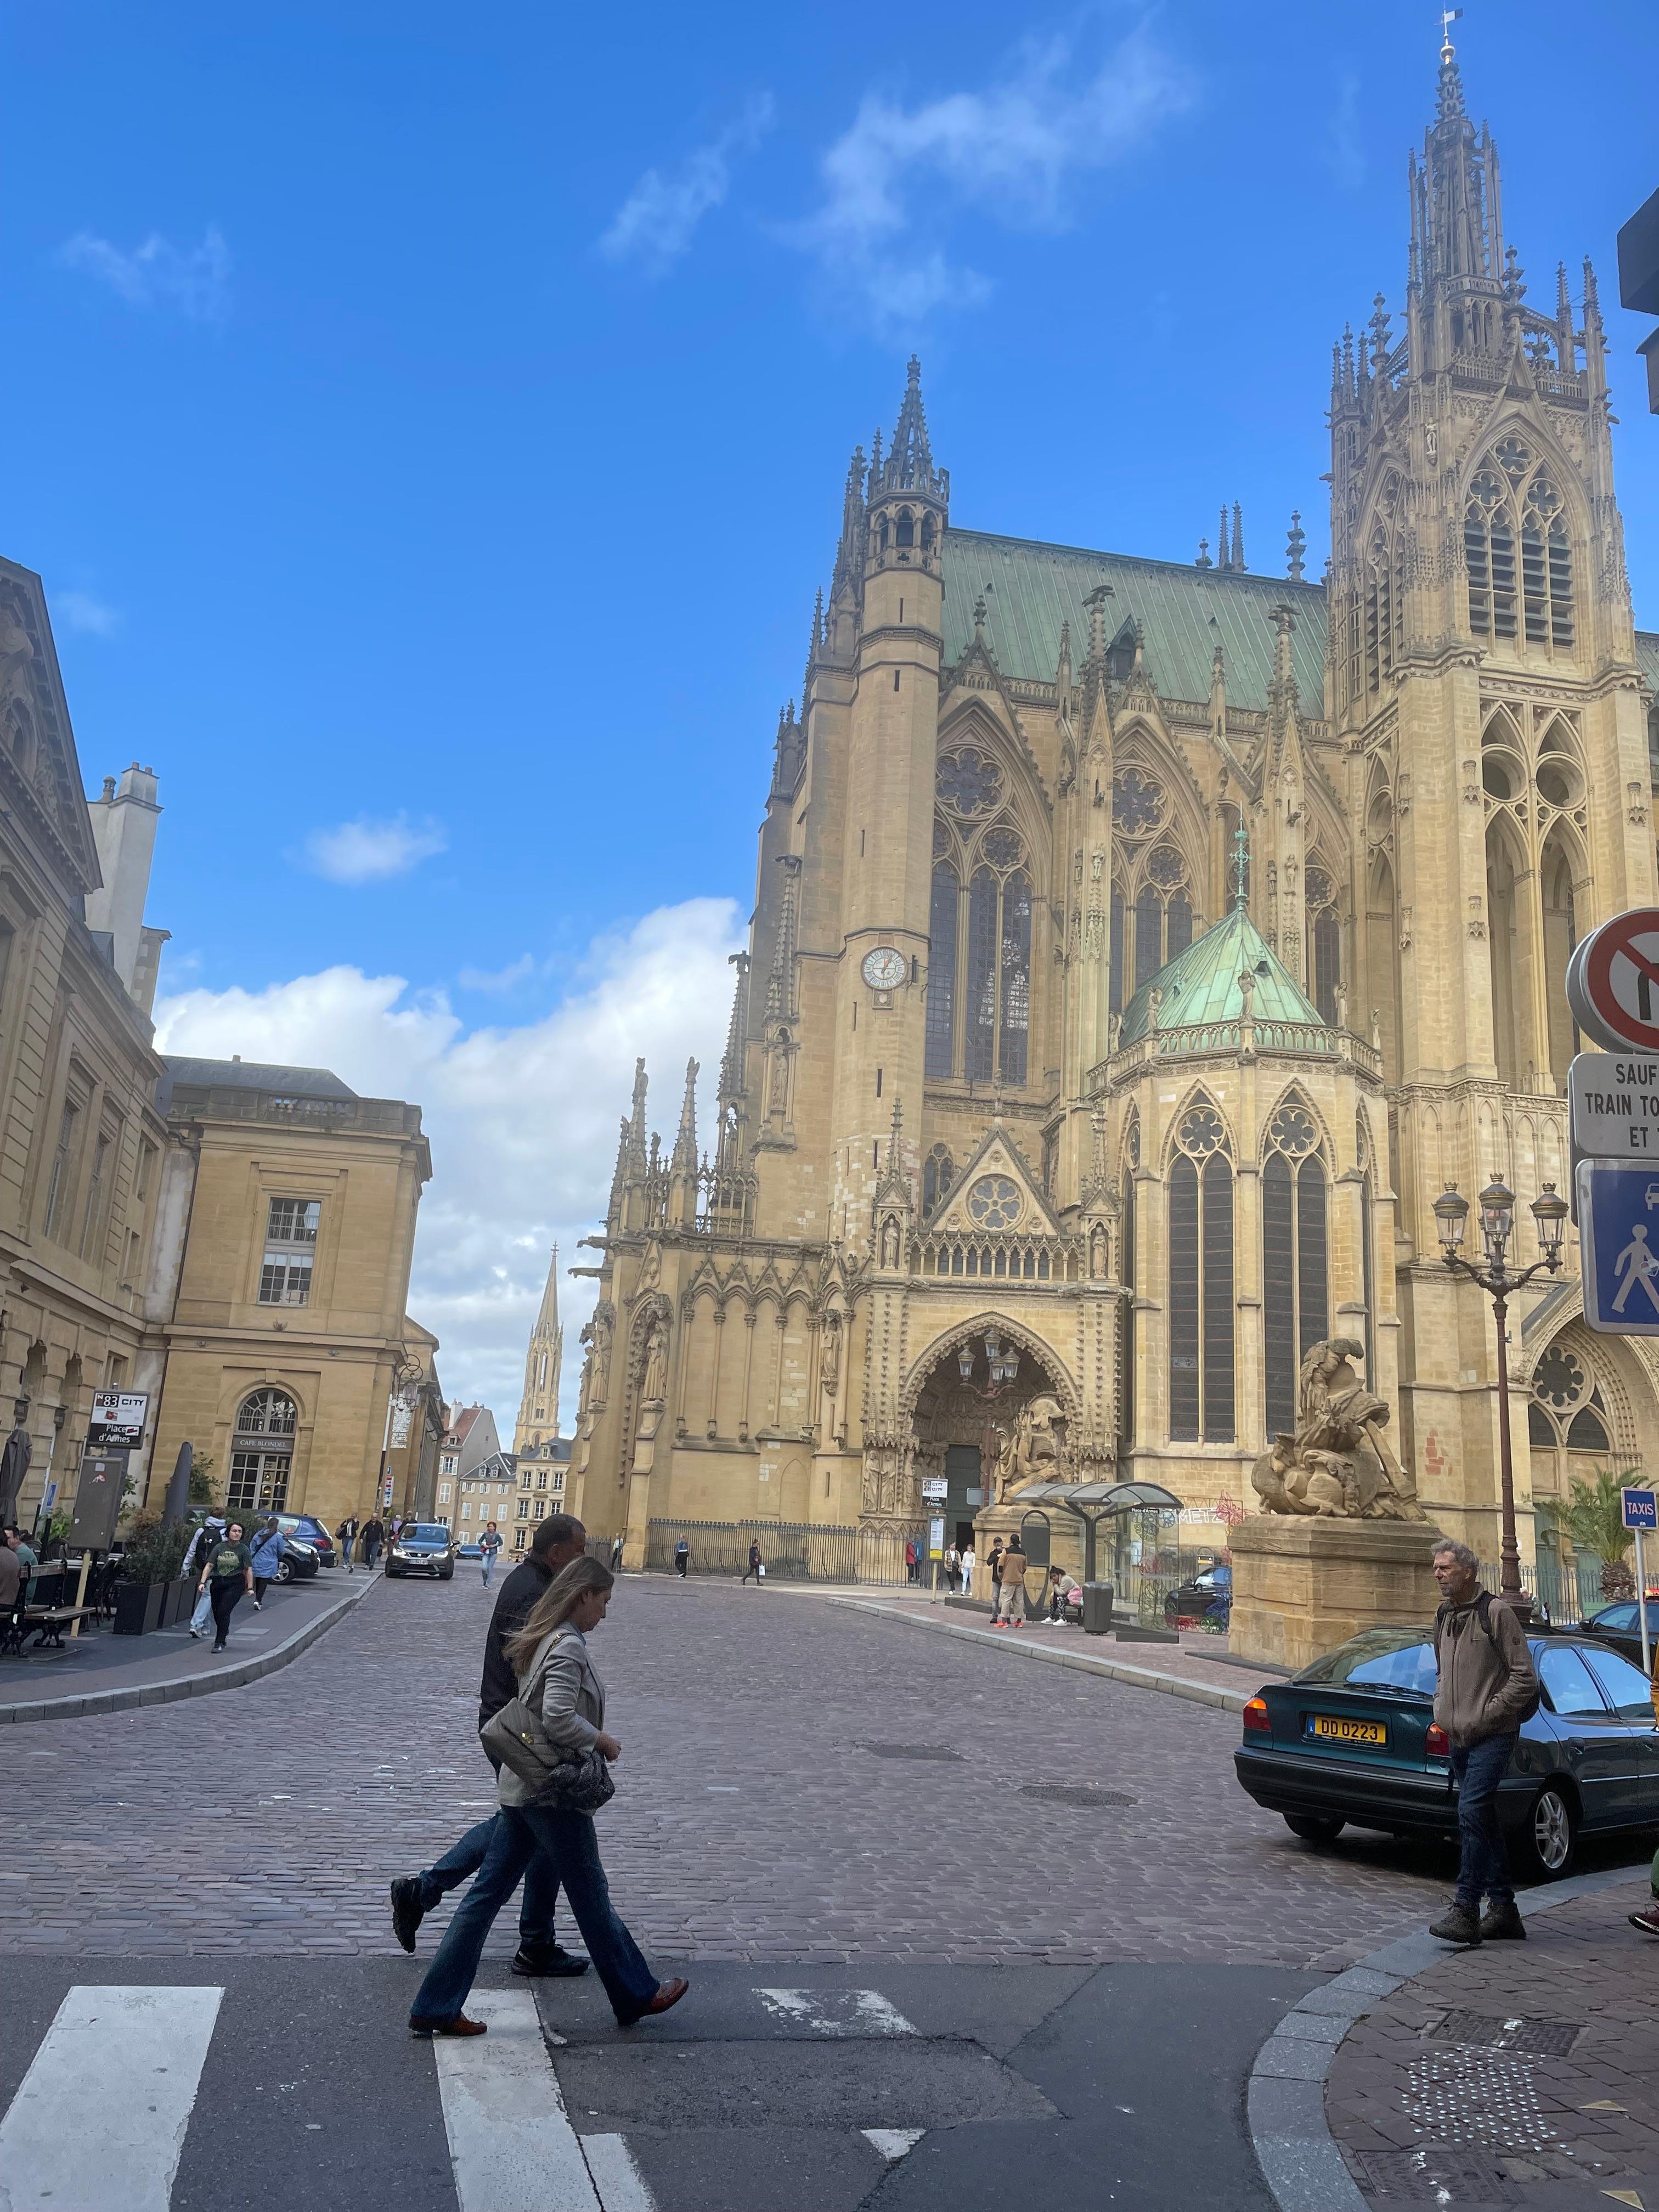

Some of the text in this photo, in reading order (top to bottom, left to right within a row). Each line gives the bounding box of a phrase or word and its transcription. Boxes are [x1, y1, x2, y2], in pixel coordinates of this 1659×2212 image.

[1616, 1063, 1657, 1085] SAUF
[1584, 1093, 1632, 1115] TRAIN
[1629, 1126, 1648, 1148] ET
[103, 1396, 118, 1407] 83
[106, 1424, 126, 1432] Place
[1627, 1502, 1654, 1515] TAXIS
[1322, 1719, 1338, 1735] DD
[1342, 1722, 1378, 1740] 0223
